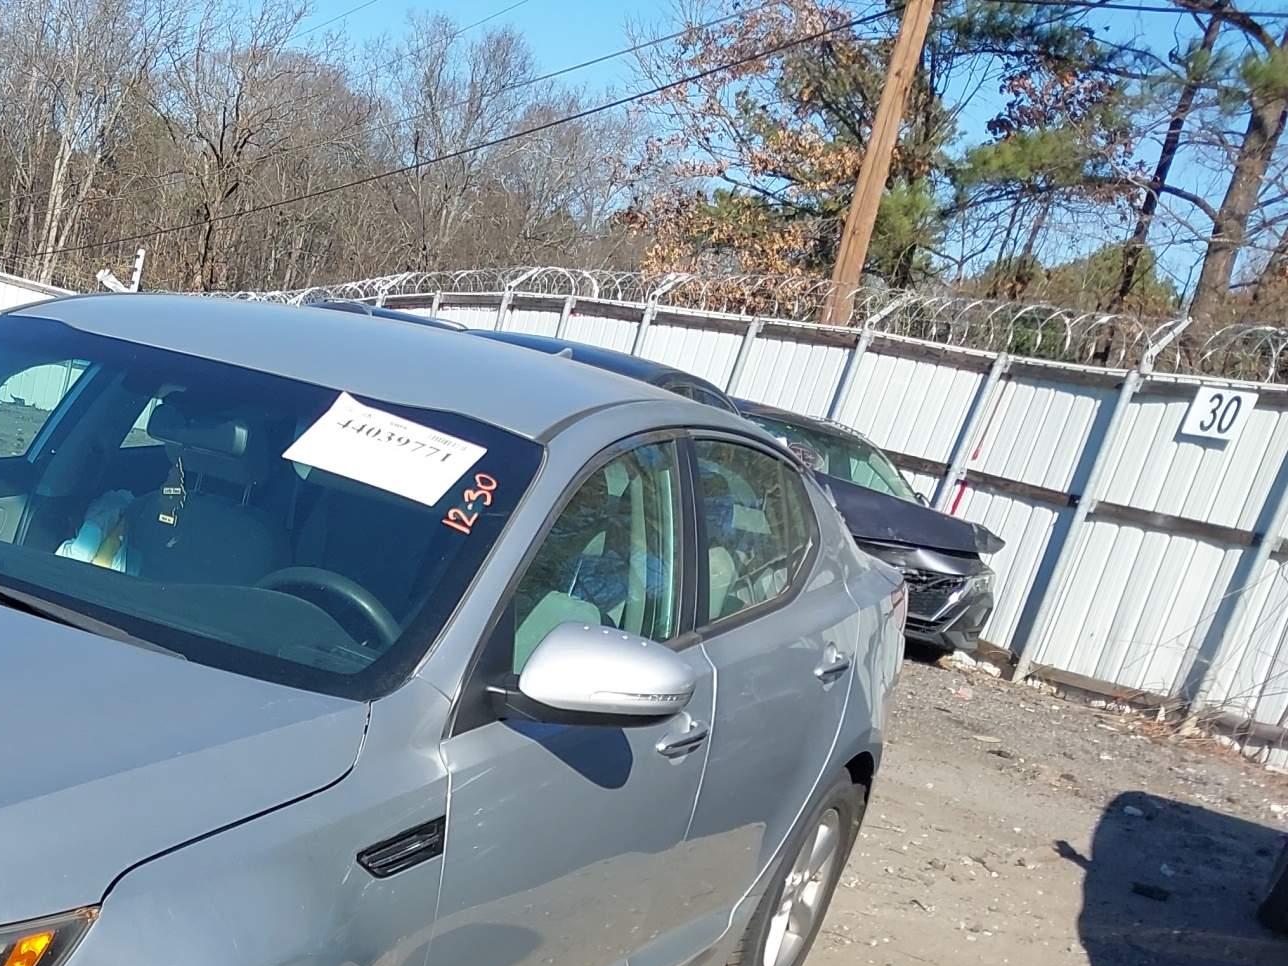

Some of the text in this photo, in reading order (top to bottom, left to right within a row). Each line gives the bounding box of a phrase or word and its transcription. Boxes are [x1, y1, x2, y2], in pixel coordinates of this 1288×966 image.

[1199, 393, 1242, 434] 30
[337, 418, 452, 463] 44039771
[442, 472, 497, 535] 12-30
